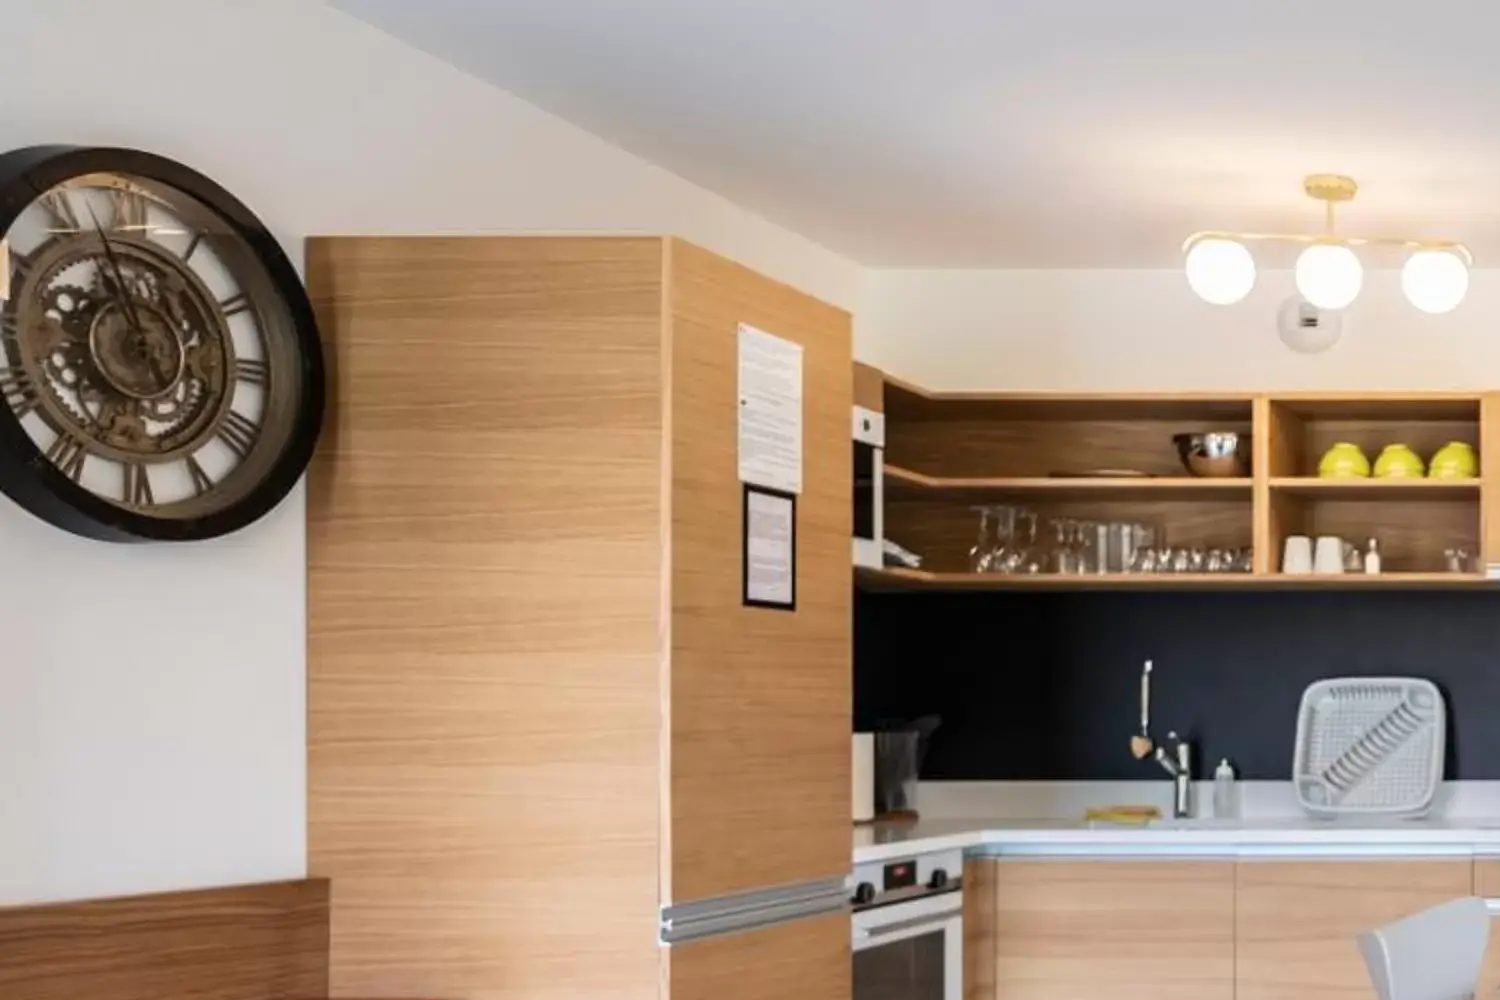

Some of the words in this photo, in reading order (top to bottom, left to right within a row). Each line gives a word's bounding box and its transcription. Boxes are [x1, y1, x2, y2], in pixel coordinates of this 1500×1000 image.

[219, 291, 254, 317] II
[235, 357, 267, 384] III
[215, 410, 259, 460] IIII
[123, 462, 154, 505] VI
[186, 456, 214, 496] V
